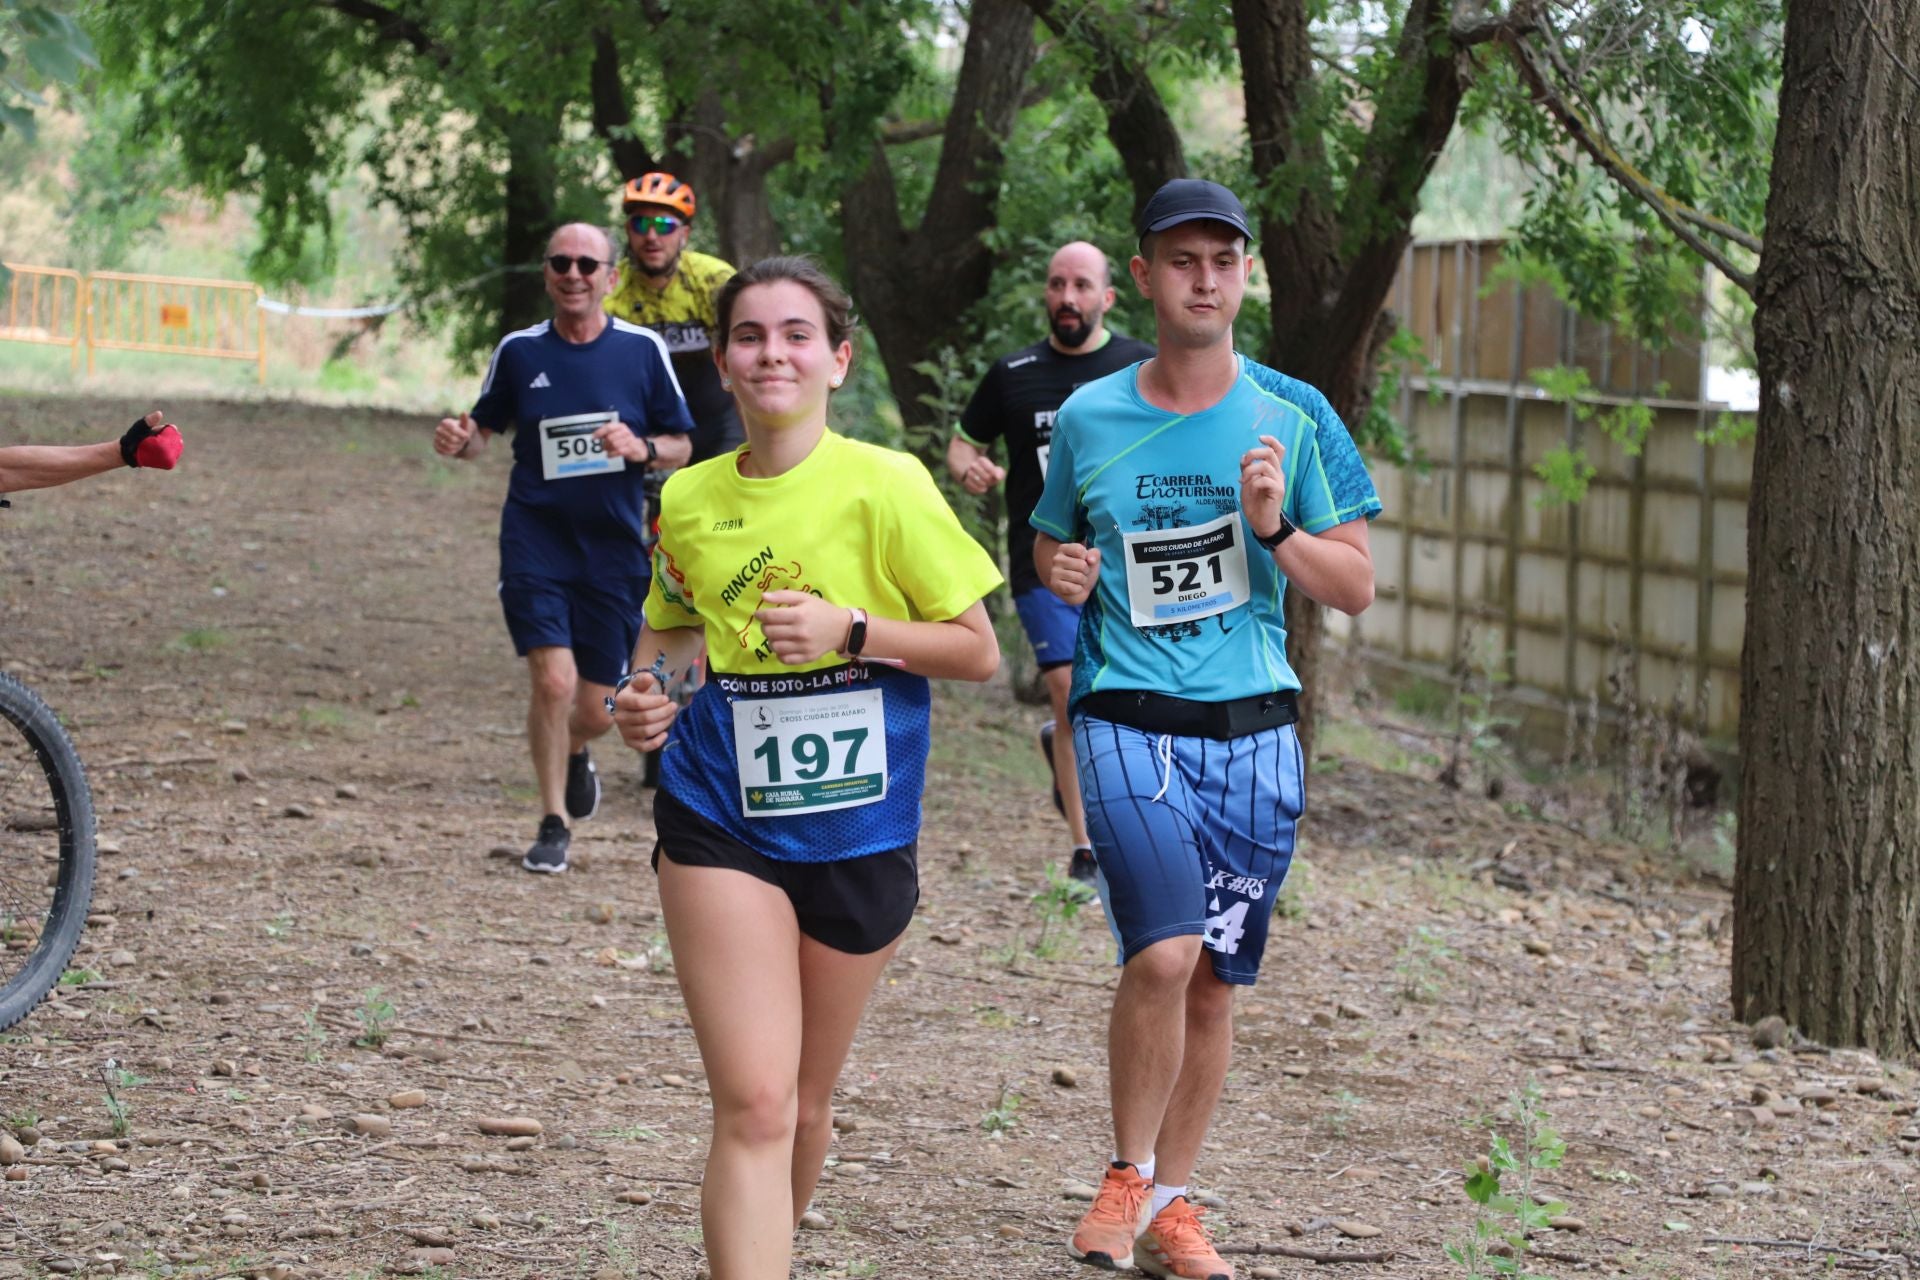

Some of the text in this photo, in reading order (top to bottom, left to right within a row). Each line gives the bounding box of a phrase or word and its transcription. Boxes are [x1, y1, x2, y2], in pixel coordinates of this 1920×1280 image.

[557, 438, 604, 458] 508
[1152, 474, 1212, 487] CARRERA
[712, 518, 744, 532] GOBIK
[1148, 545, 1168, 553] CROSS
[1168, 541, 1193, 551] CIUDAD
[1193, 540, 1203, 548] DE
[1202, 532, 1225, 546] ALFARO
[720, 546, 774, 607] RINCON
[1151, 554, 1223, 595] 521
[1178, 591, 1207, 602] DIEGO
[1176, 599, 1217, 613] KILOMETROS
[717, 677, 748, 693] CÓN
[750, 681, 768, 693] DE
[771, 679, 804, 693] SOTO
[812, 676, 832, 688] LA
[779, 715, 803, 723] CROSS
[803, 712, 830, 721] CIUDAD
[841, 708, 866, 716] ALFARO
[754, 727, 868, 783] 197
